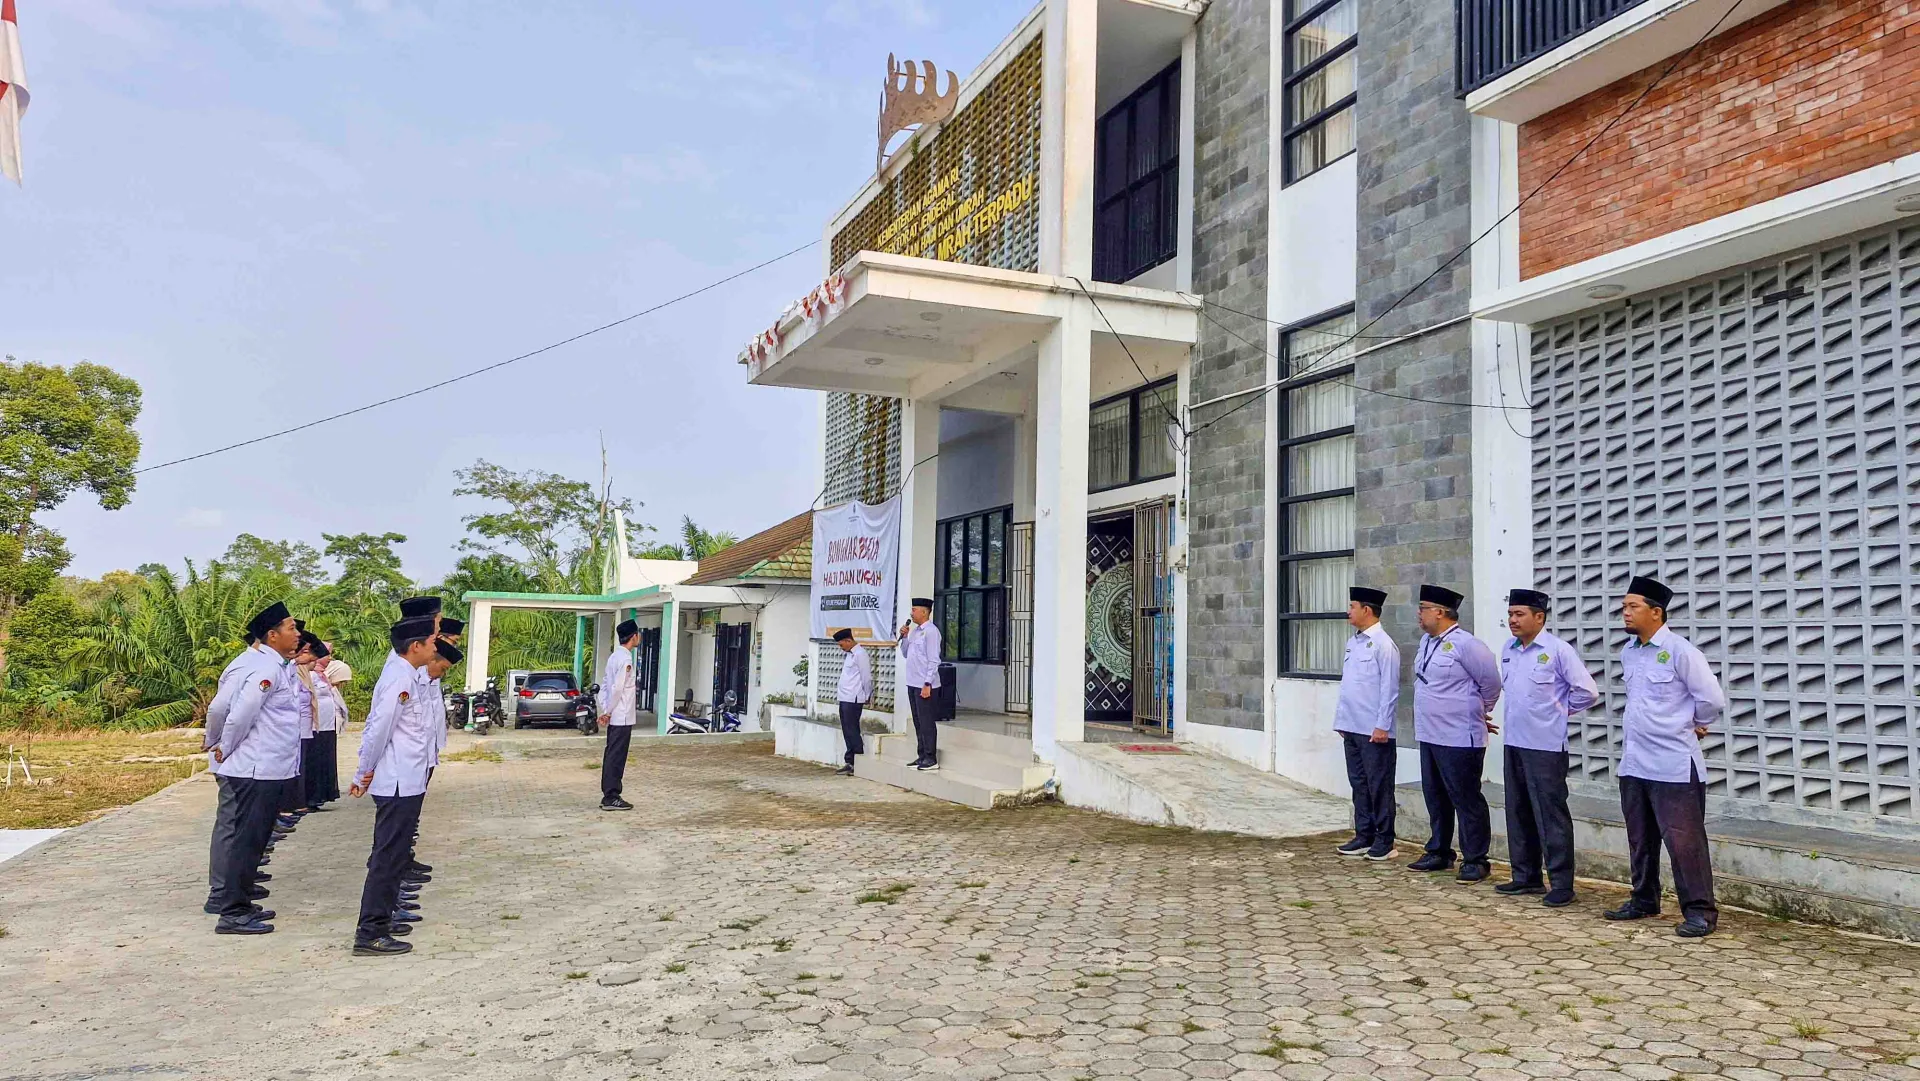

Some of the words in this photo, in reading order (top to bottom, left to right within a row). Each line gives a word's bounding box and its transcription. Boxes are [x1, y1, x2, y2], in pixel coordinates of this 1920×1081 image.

[877, 201, 922, 248] KEMENTERIAN
[922, 176, 950, 209] AGAMA
[950, 166, 959, 185] RI
[919, 191, 957, 232] JENDERAL
[930, 221, 971, 261] MRAH
[973, 173, 1034, 238] TERPADU
[938, 212, 954, 238] DAN
[956, 186, 985, 223] UMRAH
[823, 571, 838, 587] HAJI
[839, 569, 855, 586] DAN
